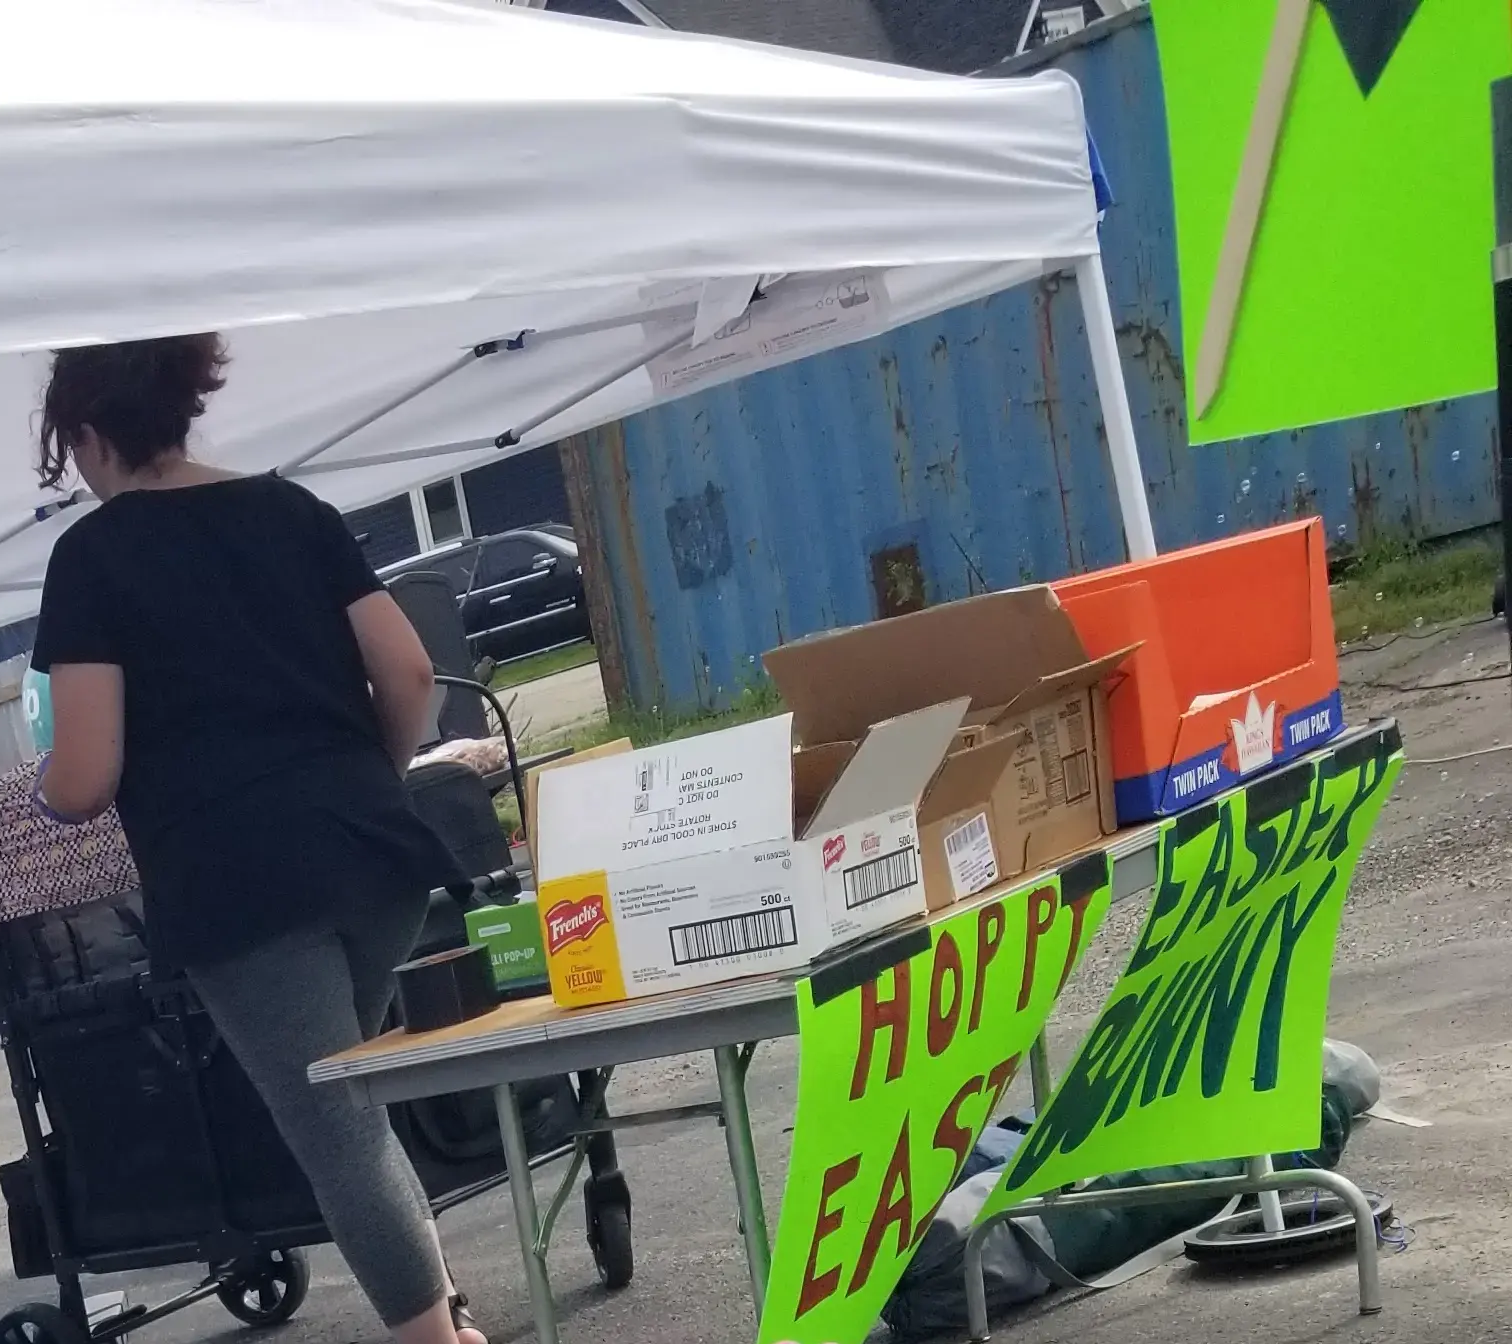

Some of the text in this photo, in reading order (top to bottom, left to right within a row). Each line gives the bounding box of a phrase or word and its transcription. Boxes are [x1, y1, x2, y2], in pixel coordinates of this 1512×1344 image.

[1289, 708, 1331, 746] TWIN PACK
[680, 766, 714, 781] DO NOT
[697, 772, 743, 790] CONTENTS
[1173, 757, 1221, 799] TWIN PACK
[686, 792, 704, 804] NOT
[706, 789, 719, 800] DO
[678, 812, 711, 828] ROTATE
[621, 820, 738, 851] STORE IN COOL DRY PLACE
[898, 834, 911, 847] 500
[760, 893, 782, 906] 500
[549, 905, 598, 942] French's
[504, 947, 536, 964] POP-UP
[564, 968, 604, 990] YELLOW
[1005, 866, 1338, 1195] BUNNY
